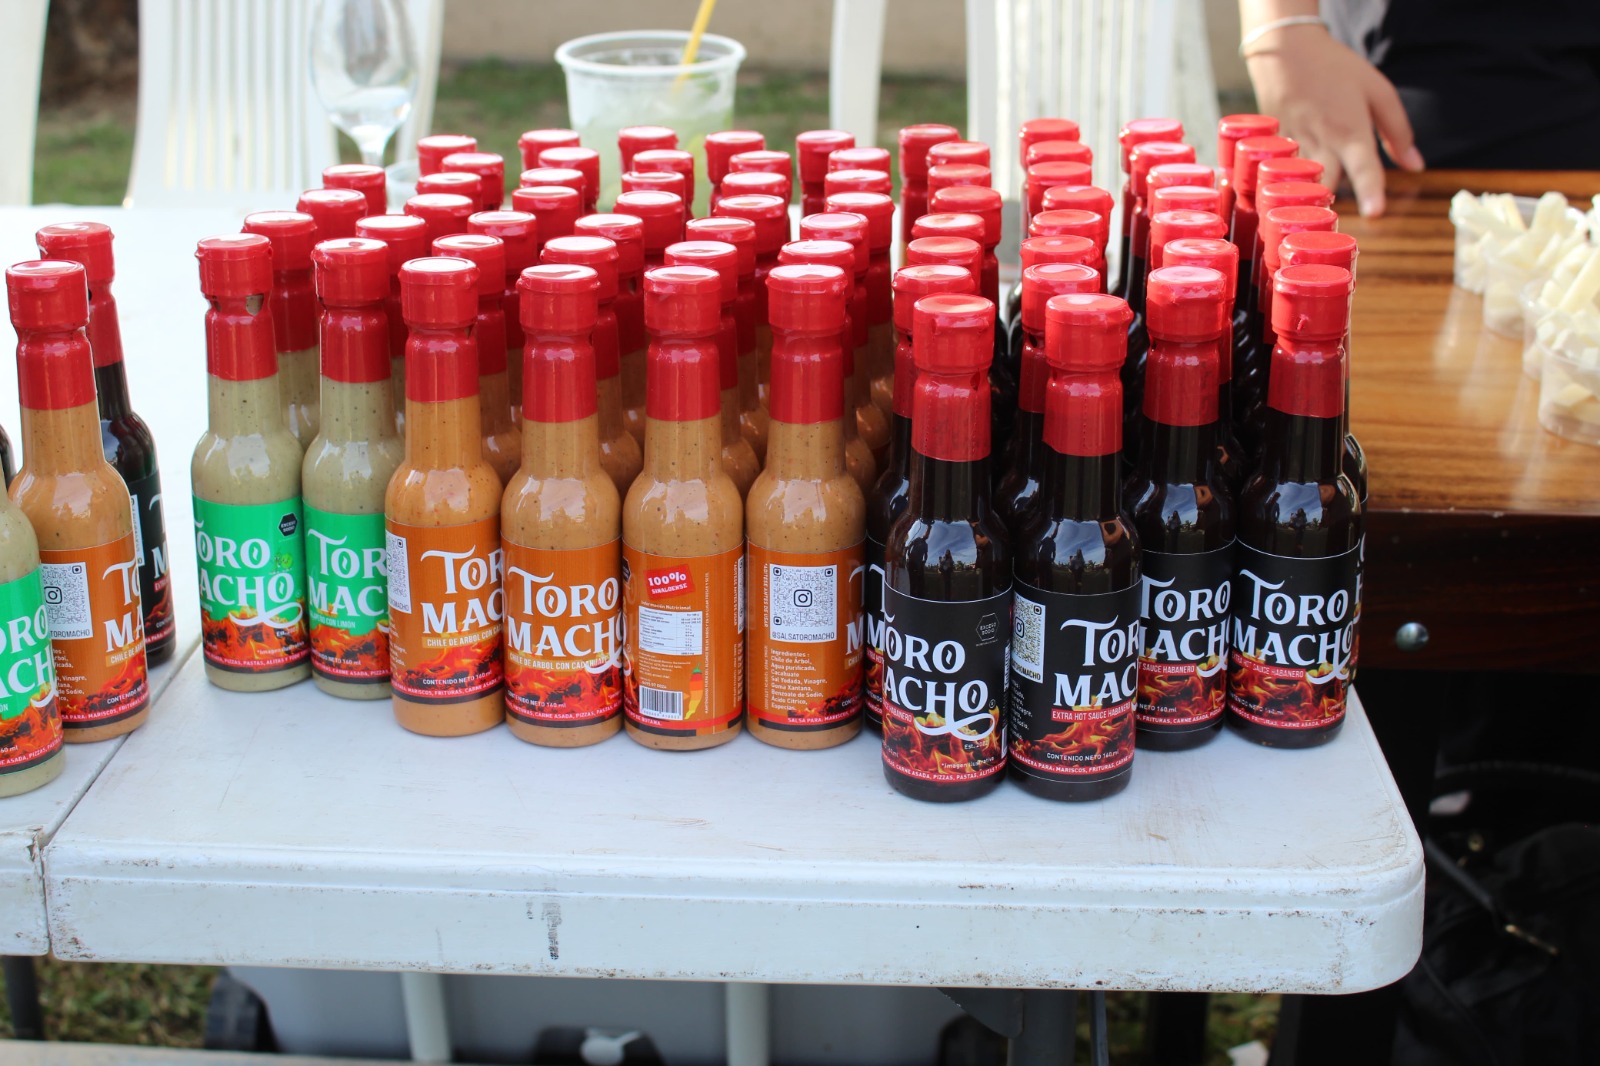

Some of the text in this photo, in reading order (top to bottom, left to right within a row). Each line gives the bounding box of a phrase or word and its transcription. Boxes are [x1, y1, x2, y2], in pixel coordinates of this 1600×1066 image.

[194, 520, 270, 569] ORO
[648, 572, 687, 586] 100%
[508, 566, 619, 618] TORO
[651, 582, 688, 594] SINALOENSE
[1141, 574, 1231, 622] TORO
[1240, 569, 1348, 627] TORO
[0, 604, 48, 657] RO
[772, 632, 834, 641] @SALSATOROMACHO
[428, 638, 448, 646] CHILE
[460, 636, 480, 644] ARBOL
[1233, 616, 1353, 684] MACHO
[510, 653, 522, 664] CHILE
[532, 661, 554, 670] ARBOL
[1142, 663, 1195, 674] SAUCE HABANERO
[1052, 702, 1131, 720] EXTRA HOT SAUCE HABANERO
[1142, 716, 1172, 724] FRITURAS,
[1047, 752, 1084, 762] CONTENIDO
[912, 771, 932, 780] ASADA,
